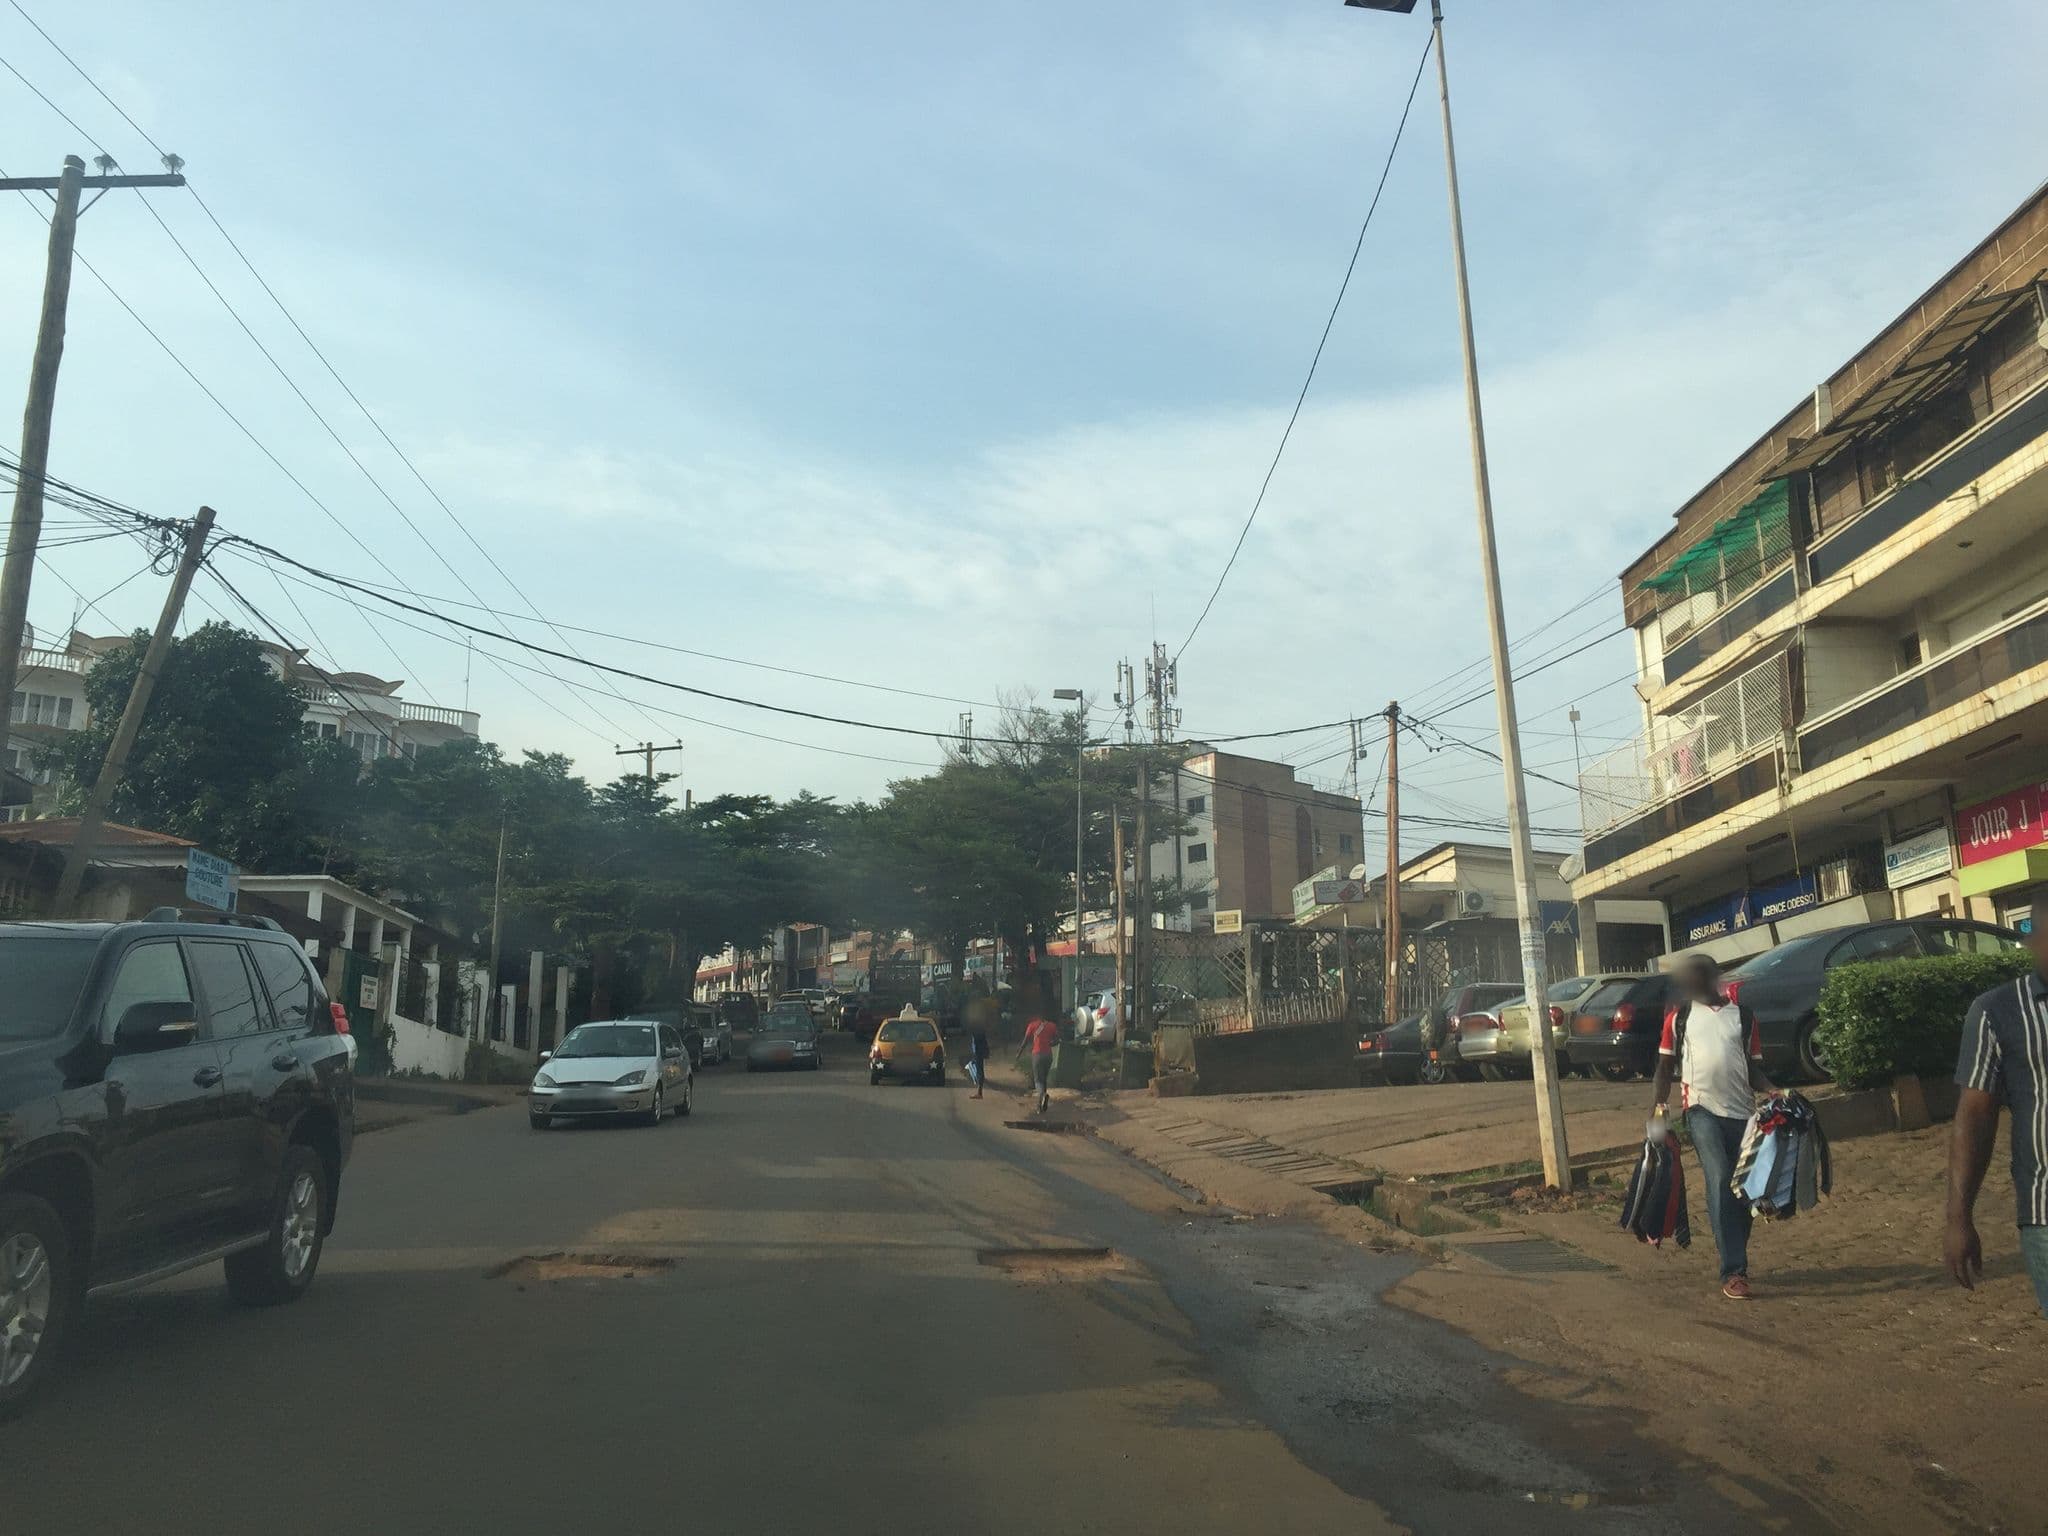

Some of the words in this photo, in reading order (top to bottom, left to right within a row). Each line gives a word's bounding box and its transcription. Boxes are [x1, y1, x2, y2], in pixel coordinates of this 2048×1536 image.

[1970, 806, 2013, 848] JOUR
[2018, 800, 2029, 832] J
[1762, 901, 1787, 918] AGENCE
[1689, 919, 1727, 941] ASSURANCE
